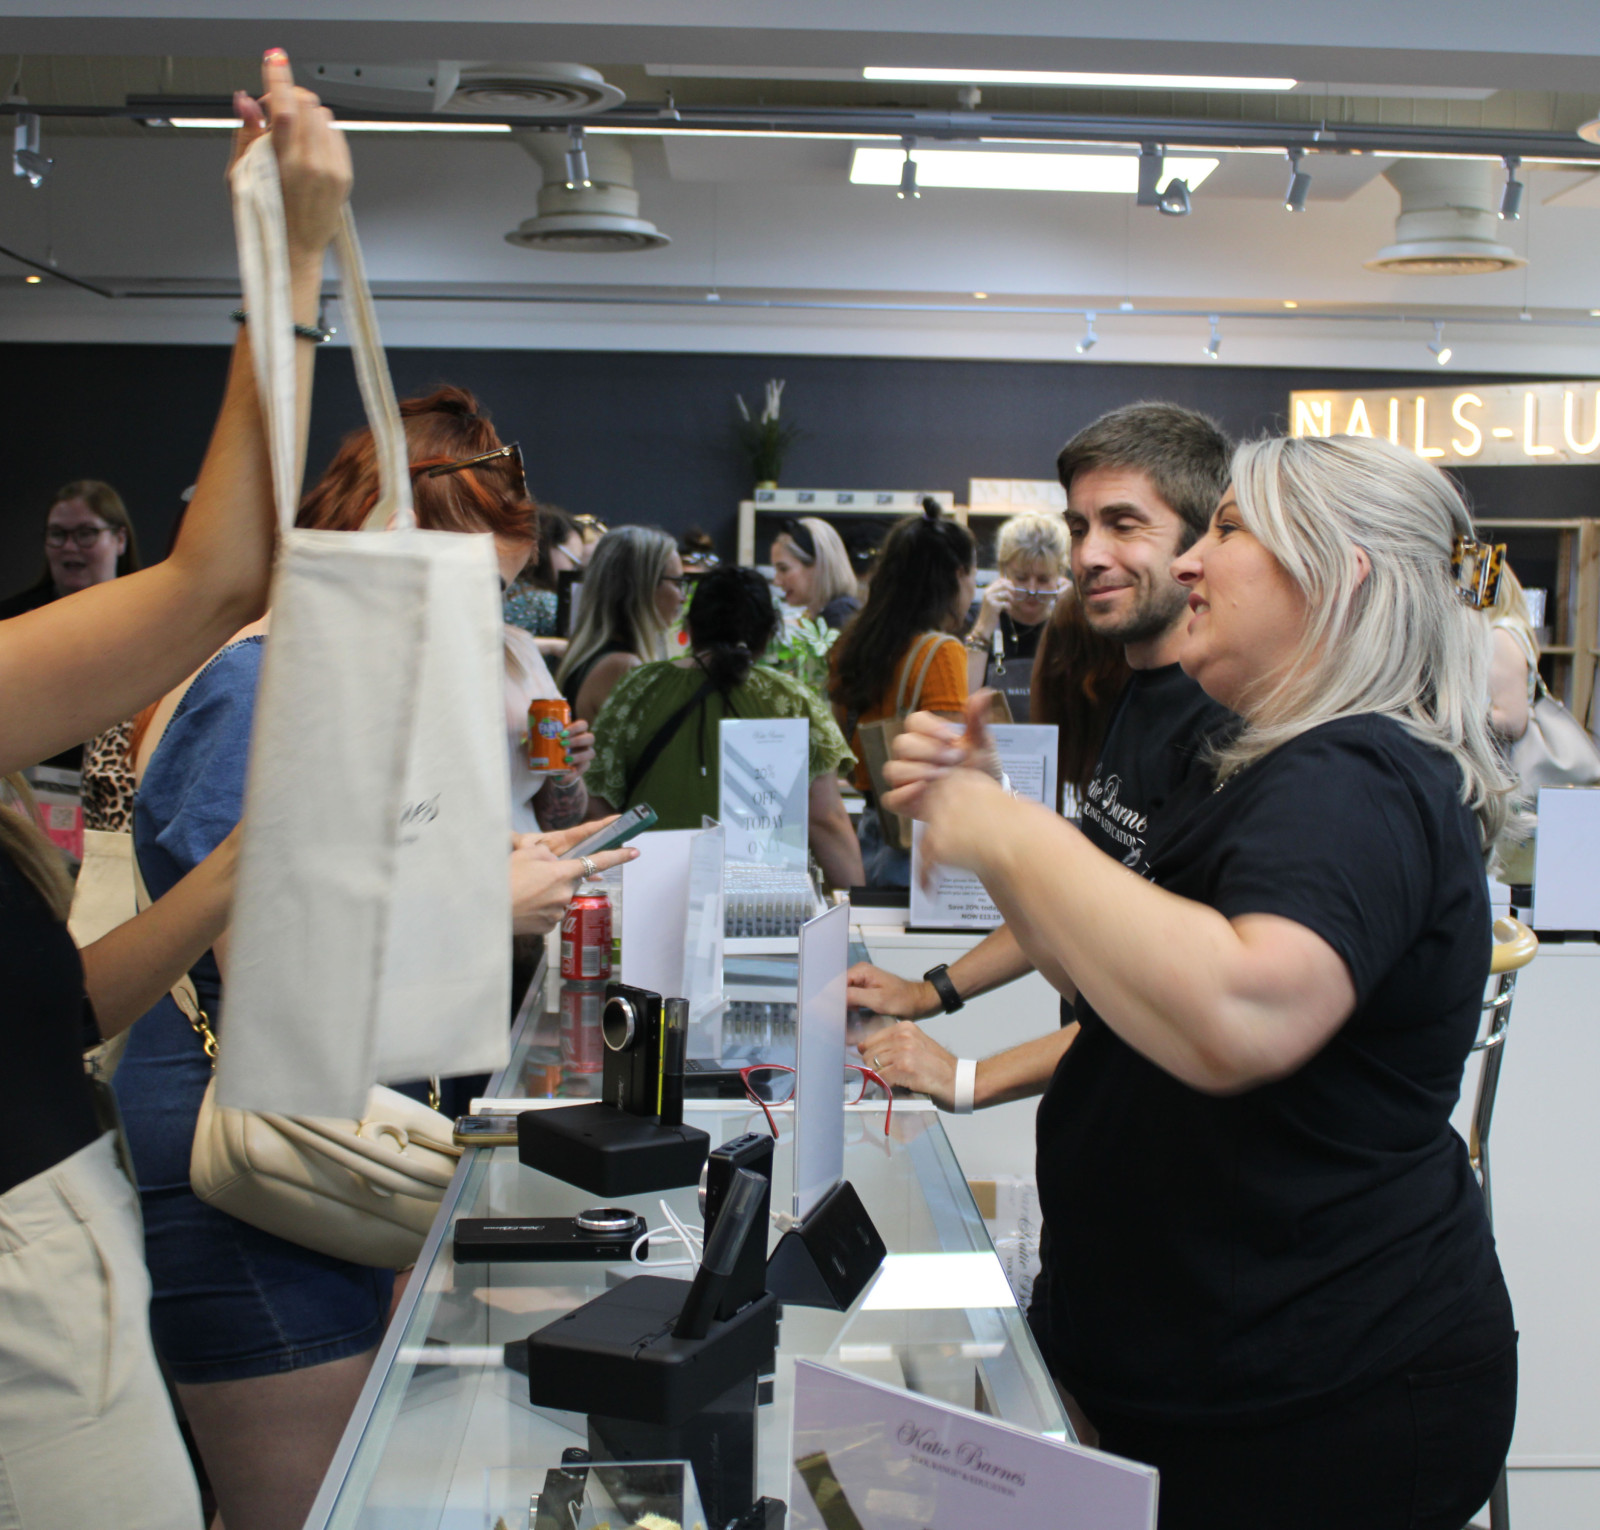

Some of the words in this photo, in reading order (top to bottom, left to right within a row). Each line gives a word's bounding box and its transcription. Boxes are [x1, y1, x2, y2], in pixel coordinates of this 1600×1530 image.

[752, 790, 777, 805] OFF
[745, 815, 783, 831] TODAY
[897, 1420, 951, 1458] Katie
[957, 1441, 1026, 1487] Barnes
